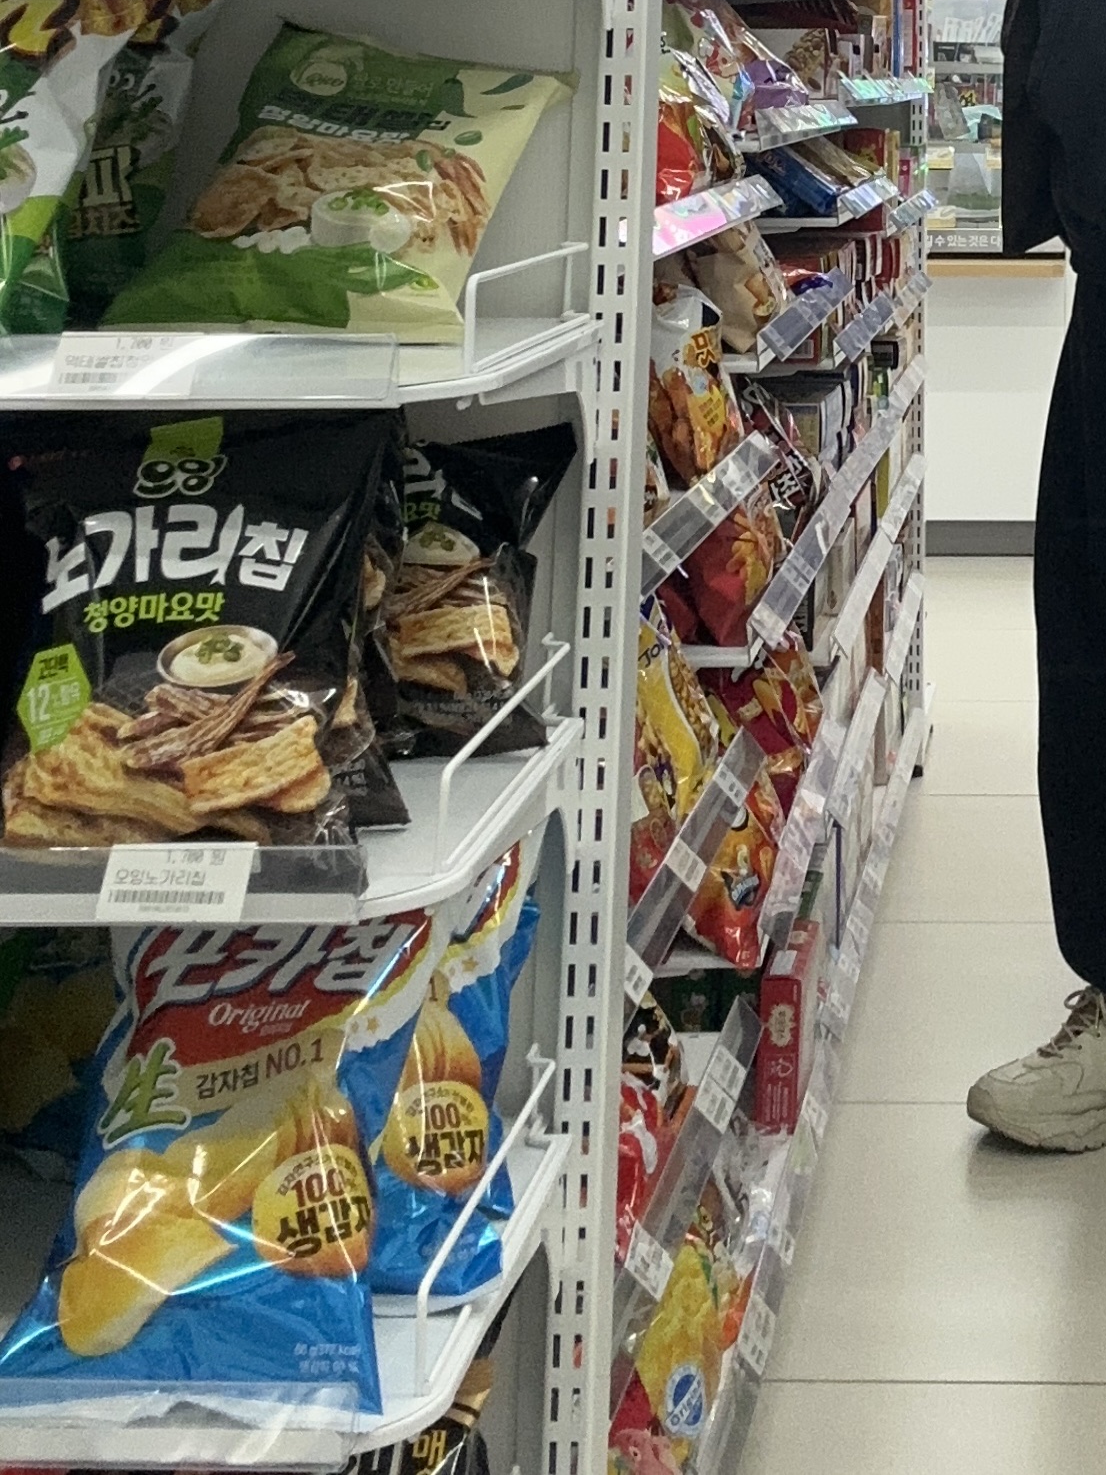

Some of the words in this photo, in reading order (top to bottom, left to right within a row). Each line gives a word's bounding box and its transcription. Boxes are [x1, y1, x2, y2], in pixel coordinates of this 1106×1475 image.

[934, 234, 946, 248] 수
[946, 234, 967, 248] 있는
[968, 234, 989, 248] 것은
[41, 503, 311, 616] 노가리칩
[83, 590, 227, 634] 청양마요맛
[27, 683, 52, 724] 12
[208, 998, 312, 1036] Original
[197, 1065, 260, 1100] 감자칩
[266, 1037, 325, 1077] NO.1
[276, 1195, 373, 1259] 생감자
